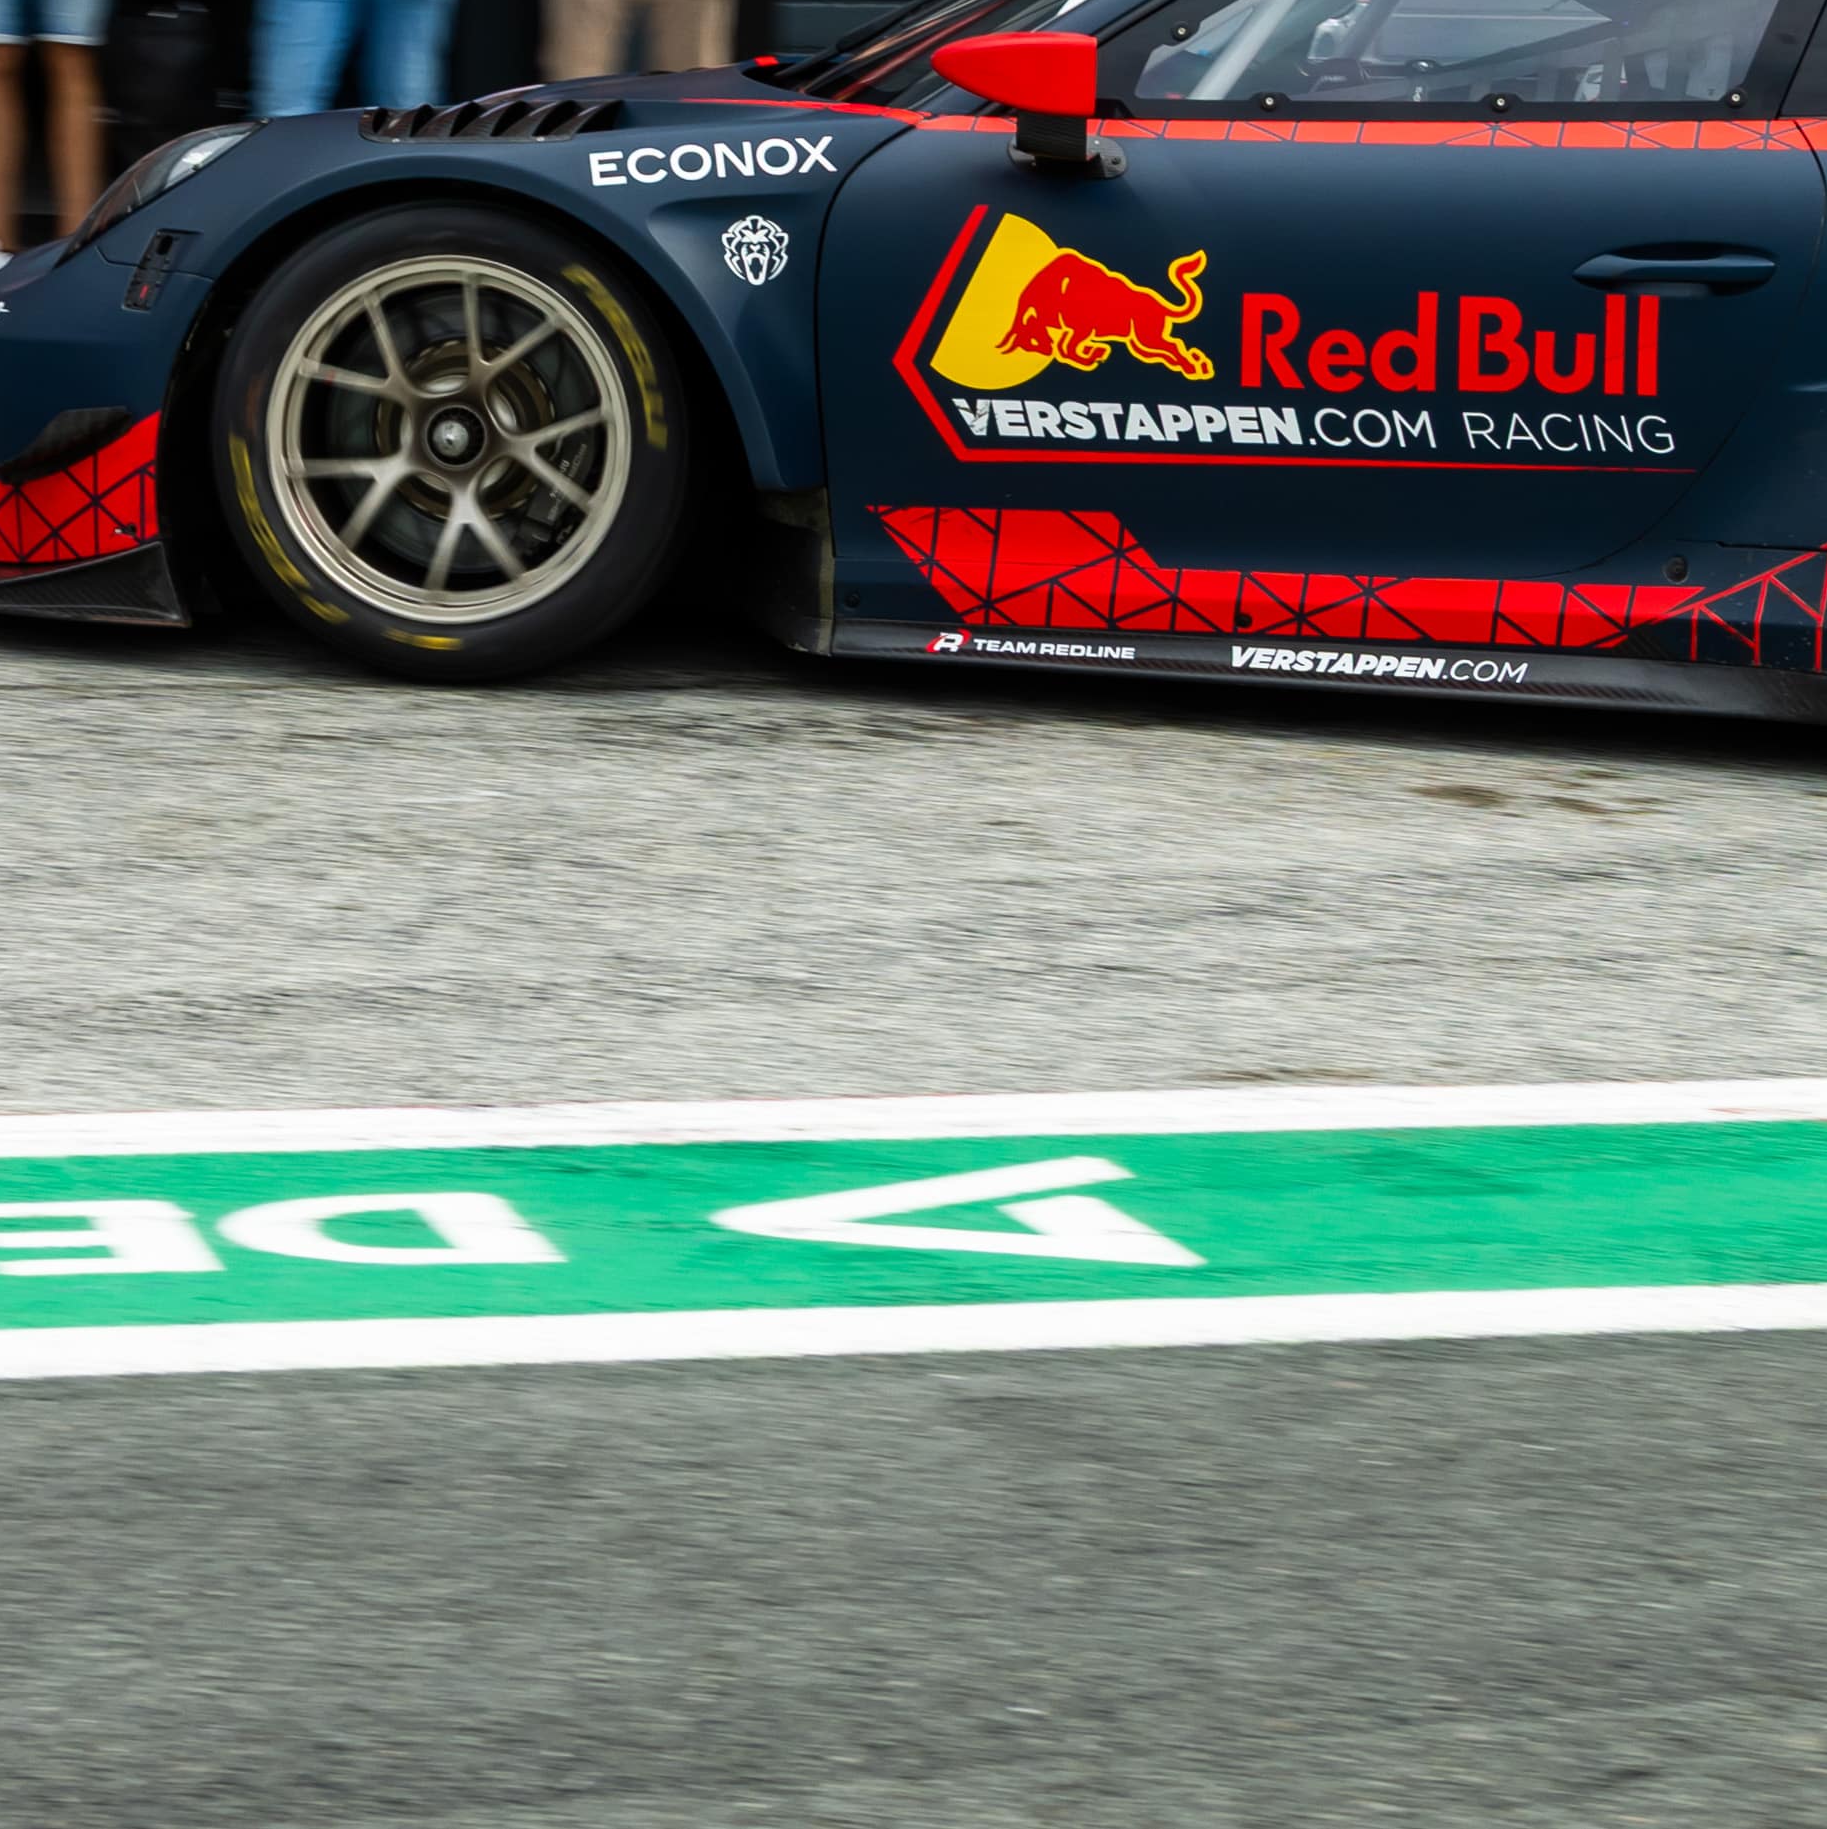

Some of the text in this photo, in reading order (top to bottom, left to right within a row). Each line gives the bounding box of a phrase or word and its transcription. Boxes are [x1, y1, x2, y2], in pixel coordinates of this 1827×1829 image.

[589, 136, 838, 186] ECONOX
[1241, 291, 1660, 396] Red Bull
[953, 397, 1675, 453] VERSTAPPEN.COM RACING
[973, 638, 1135, 660] TEAM REDLINE
[1231, 646, 1528, 683] VERSTAPPEN.COM
